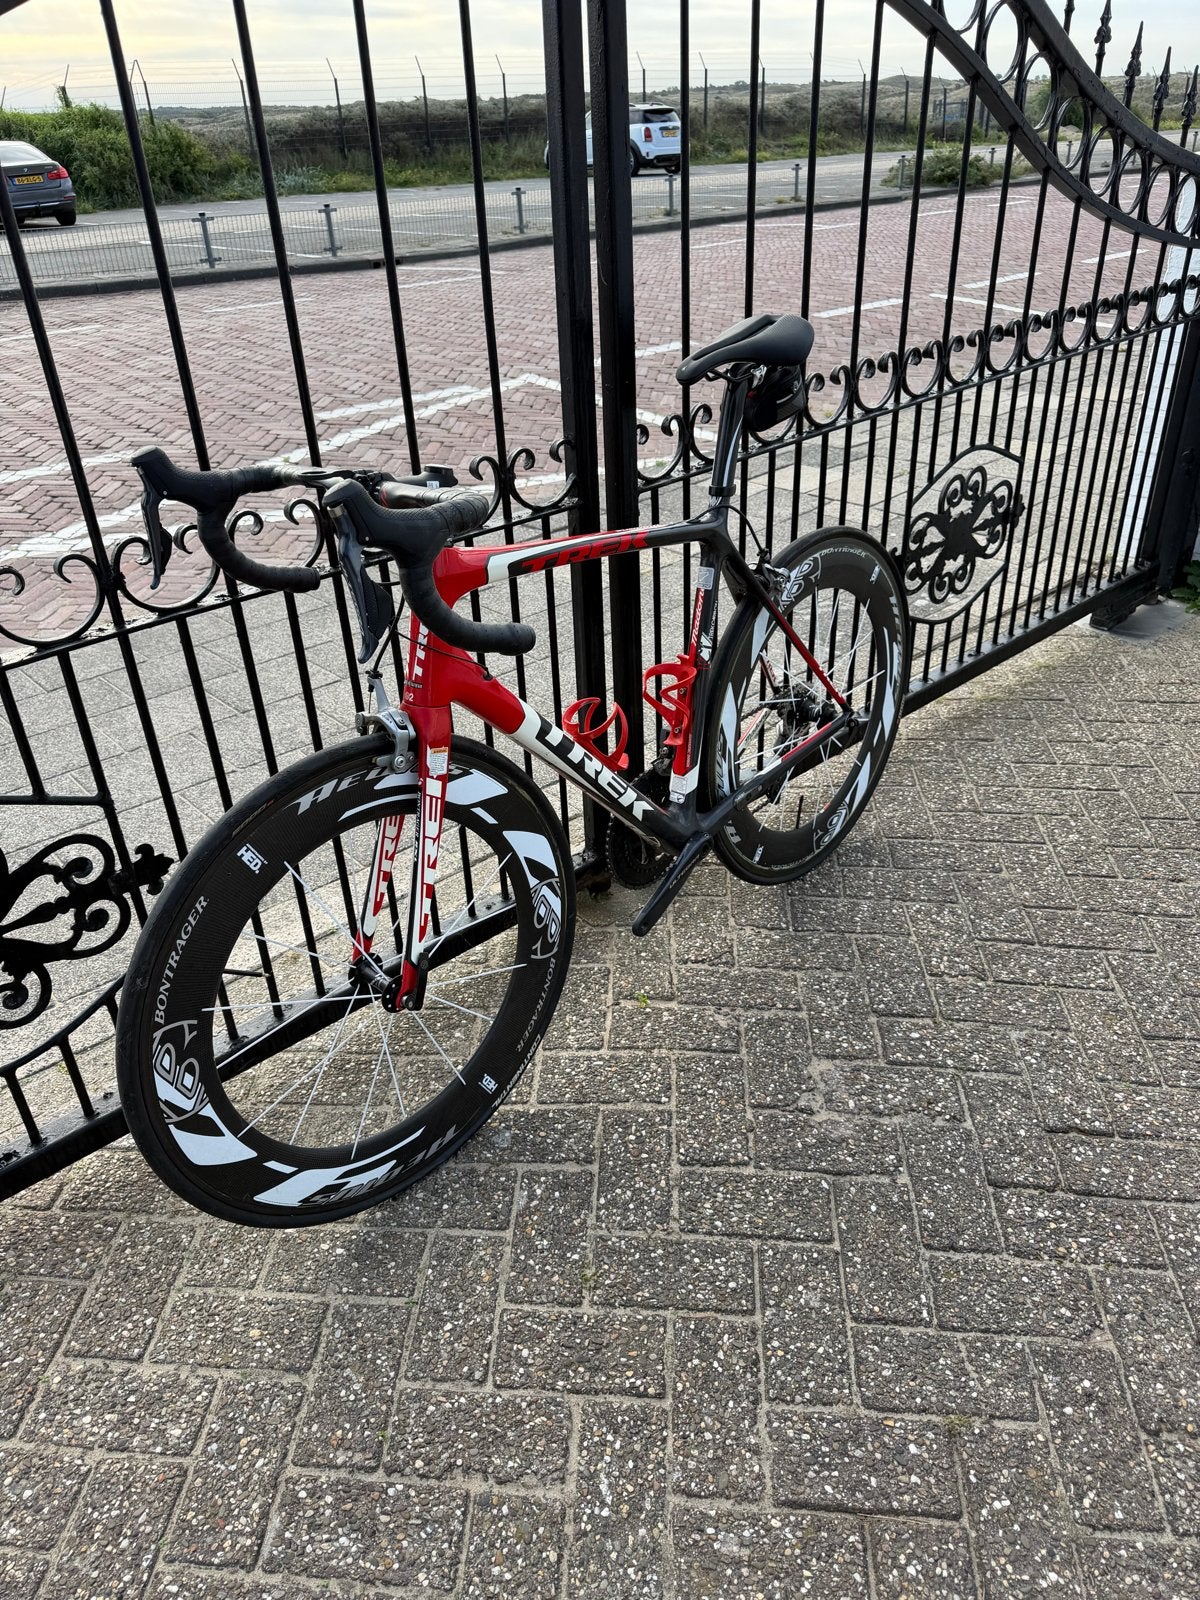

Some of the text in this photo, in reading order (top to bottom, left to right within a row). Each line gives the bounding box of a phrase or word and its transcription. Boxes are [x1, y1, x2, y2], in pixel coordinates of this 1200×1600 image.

[521, 531, 650, 573] TREK
[691, 588, 704, 647] Madon
[545, 723, 655, 822] TREK
[376, 814, 405, 902] TRE
[154, 895, 209, 1025] BONTRAGER
[516, 957, 557, 1053] BONTRAGER
